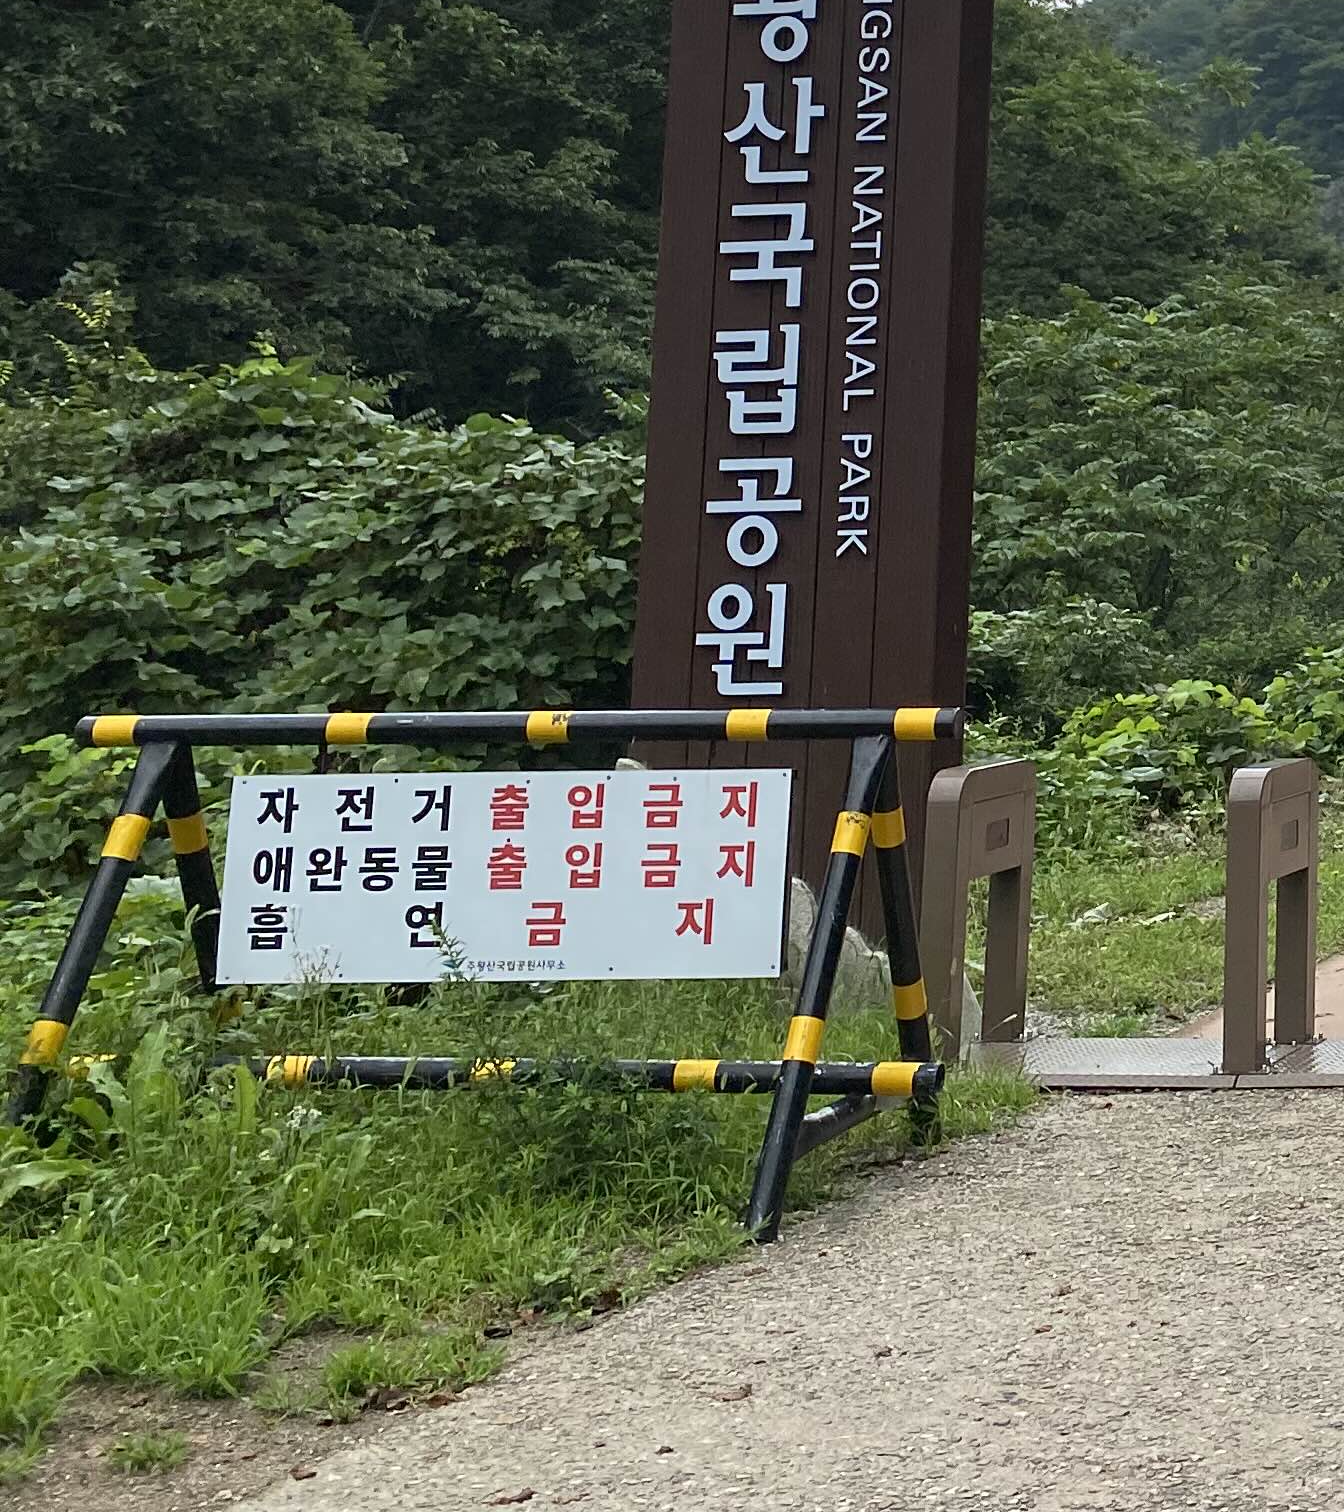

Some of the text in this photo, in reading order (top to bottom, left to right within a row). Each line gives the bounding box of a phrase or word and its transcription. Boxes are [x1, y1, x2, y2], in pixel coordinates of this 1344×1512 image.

[842, 165, 884, 413] NATIONAL
[835, 432, 873, 558] PARK
[252, 845, 453, 893] 애완동물
